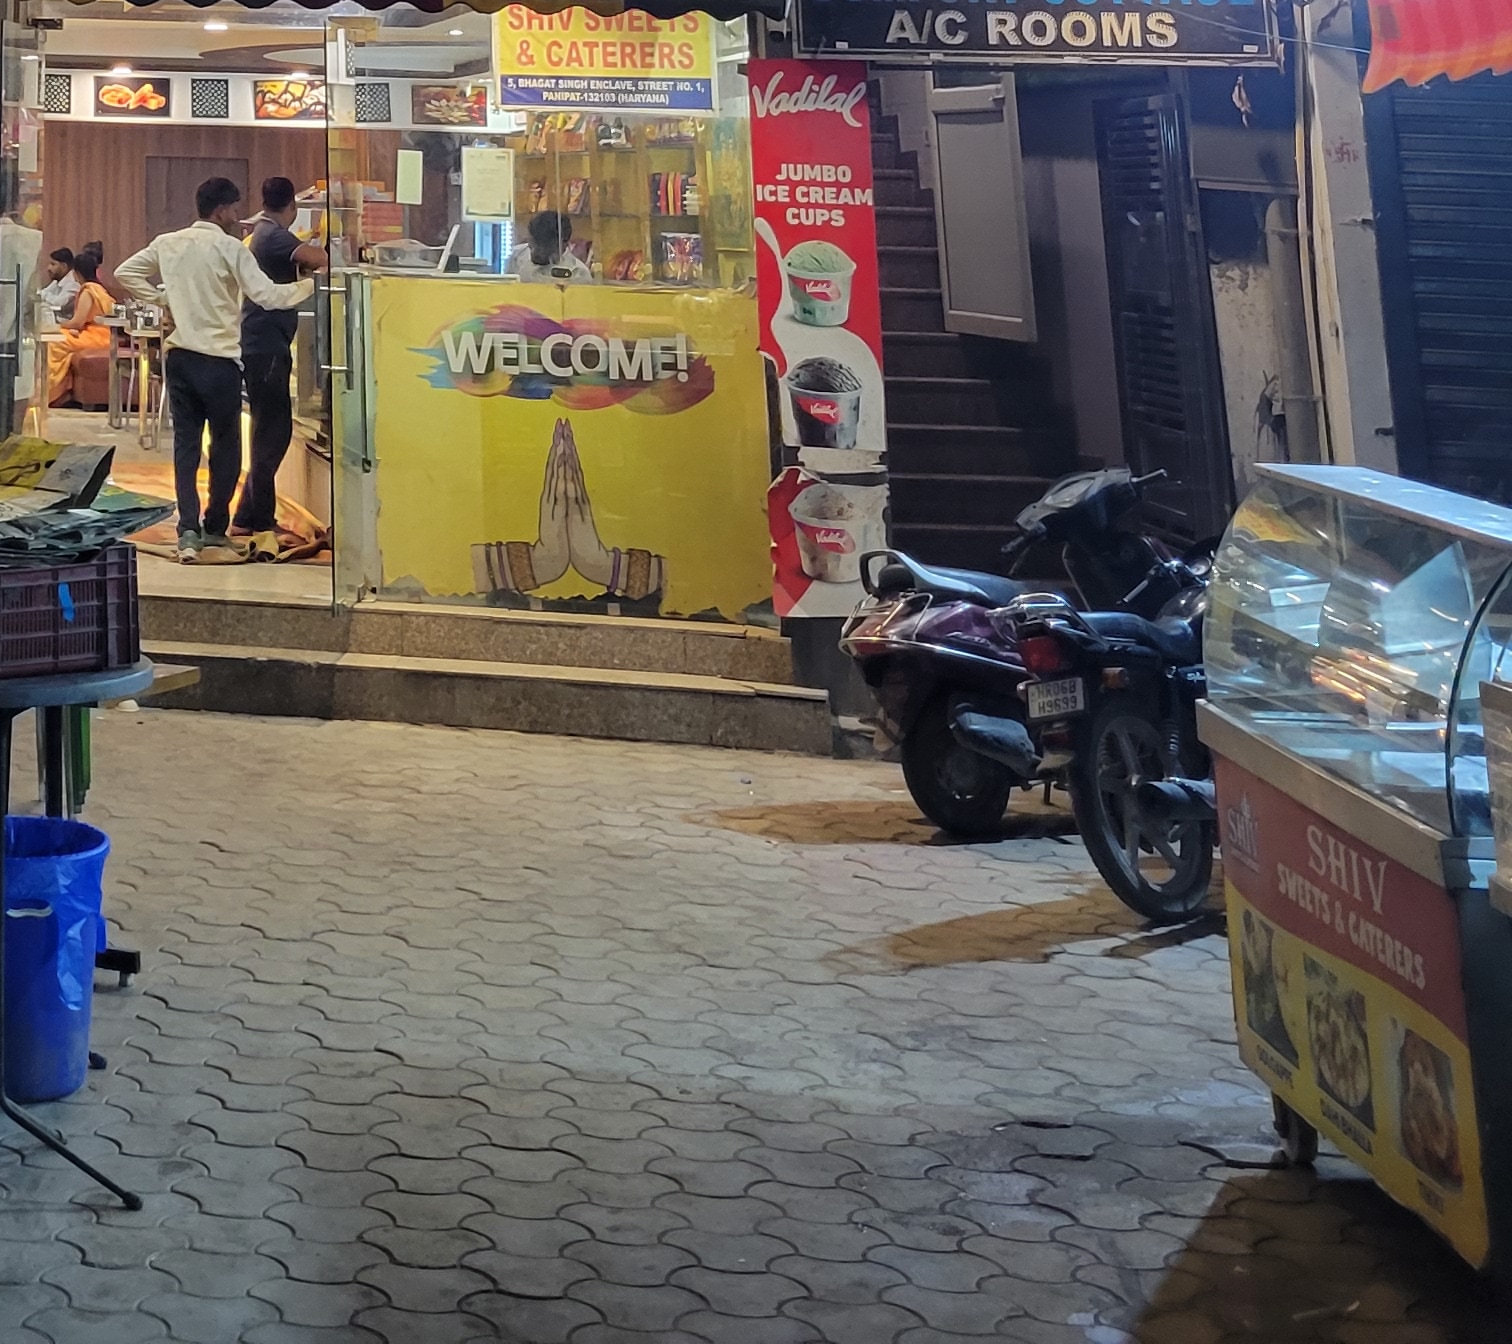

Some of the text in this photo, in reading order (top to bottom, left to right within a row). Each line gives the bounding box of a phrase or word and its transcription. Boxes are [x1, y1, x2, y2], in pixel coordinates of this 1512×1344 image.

[507, 4, 574, 32] SHIV
[886, 9, 1178, 49] A/C ROOMS
[516, 39, 695, 70] & CATERERS
[518, 79, 556, 91] BHAGAT
[558, 79, 587, 91] SINGH
[590, 80, 636, 93] ENCLAVE,
[637, 81, 674, 92] STREET
[676, 82, 694, 92] NO.
[618, 92, 670, 106] (HARYANA)
[752, 71, 867, 128] Vadilal
[775, 163, 853, 183] JUMBO
[755, 184, 874, 206] ICE CREAM
[785, 207, 846, 227] CUPS
[441, 331, 689, 382] WELCOME!
[1305, 823, 1388, 916] SHIV
[1276, 861, 1427, 992] SWEETS & CATERERS
